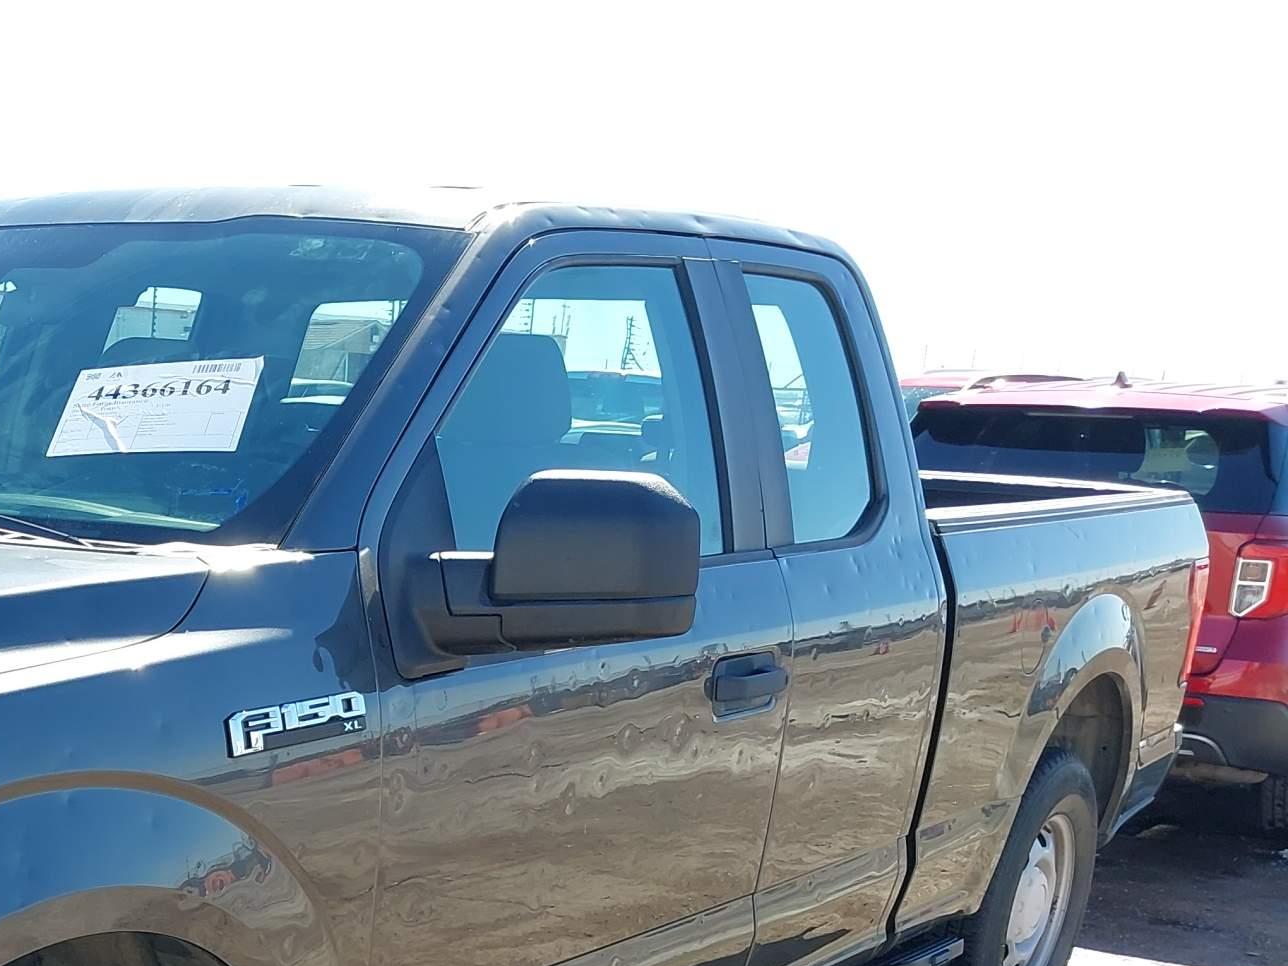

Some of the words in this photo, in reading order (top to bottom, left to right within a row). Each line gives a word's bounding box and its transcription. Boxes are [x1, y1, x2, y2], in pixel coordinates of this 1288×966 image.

[87, 378, 231, 401] 44366164
[229, 690, 367, 757] F150
[343, 720, 363, 732] XL
